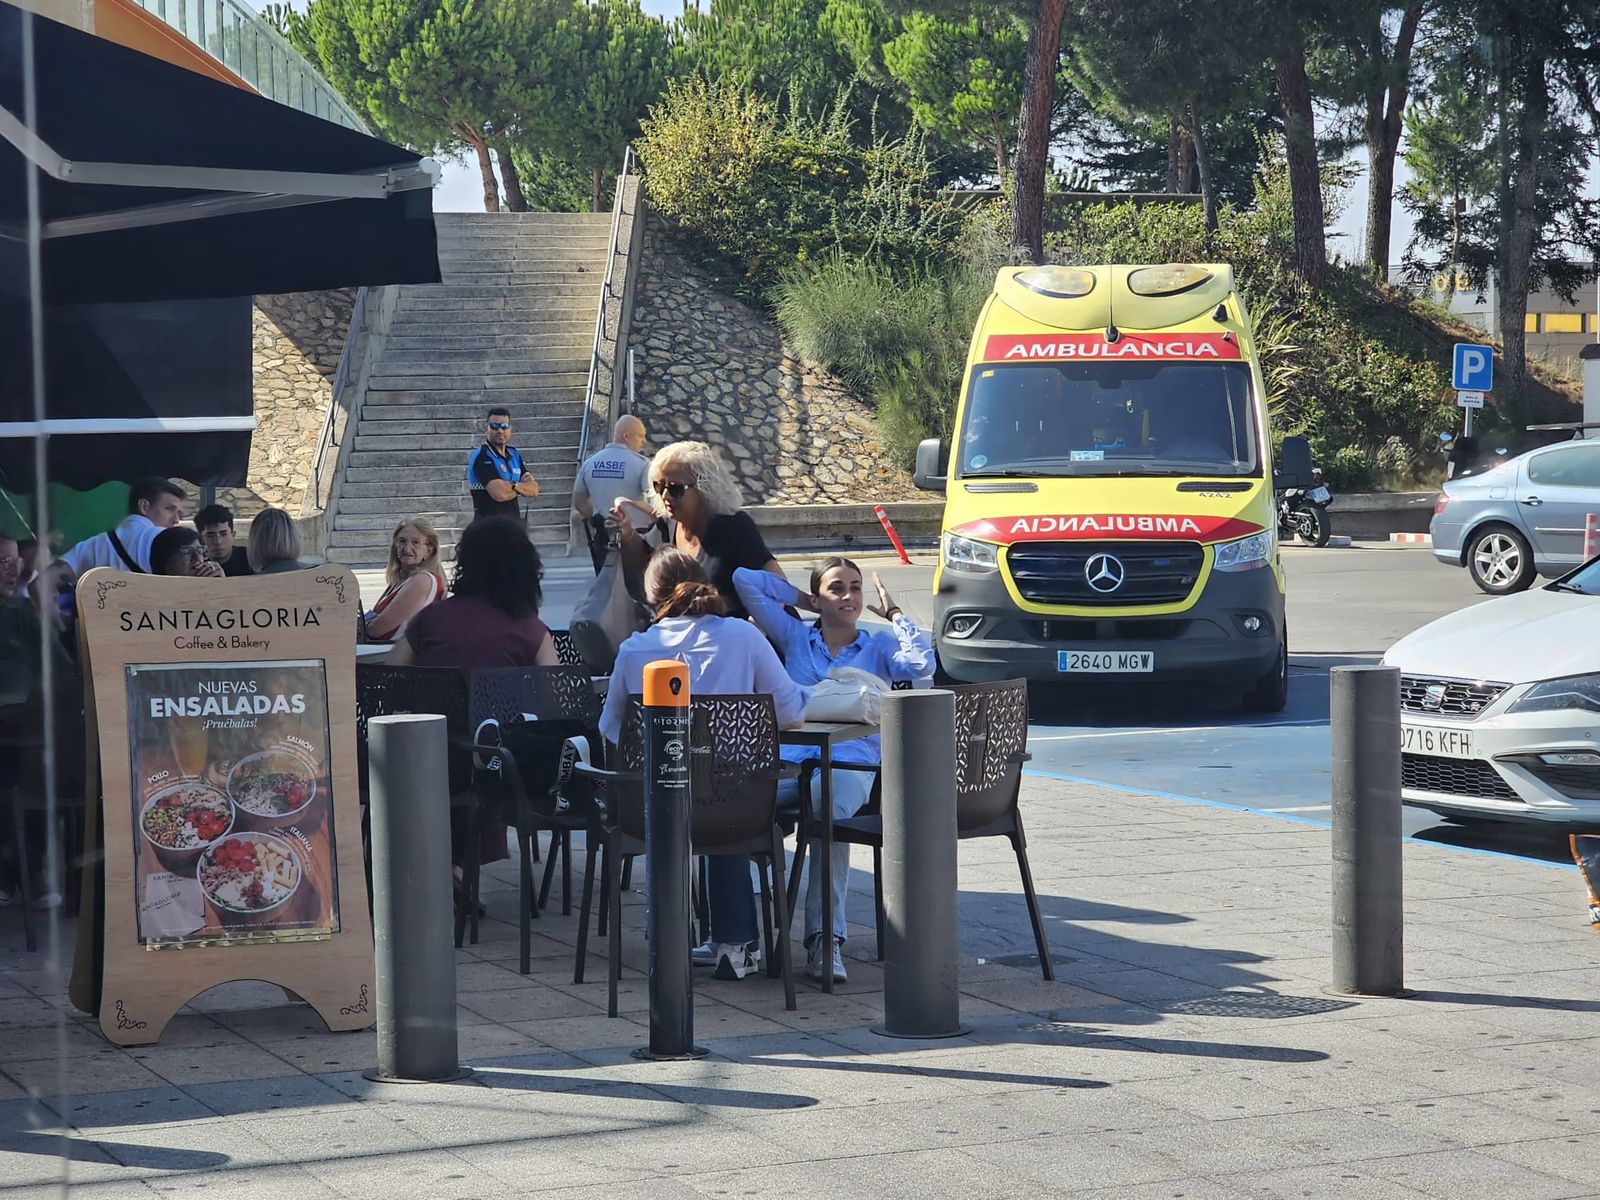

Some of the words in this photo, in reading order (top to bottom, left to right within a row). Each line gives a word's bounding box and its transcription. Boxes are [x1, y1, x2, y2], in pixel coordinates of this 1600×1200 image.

[1004, 342, 1219, 358] AMBULANCIA
[1462, 350, 1485, 385] P
[593, 461, 625, 470] VASBE
[120, 607, 321, 631] SANTAGLORIA
[174, 636, 214, 650] Coffee
[217, 637, 228, 649] &
[231, 635, 270, 651] Bakery
[1070, 654, 1112, 669] 2640
[1118, 654, 1150, 669] MGW
[198, 680, 257, 694] NUEVAS
[151, 694, 306, 718] ENSALADAS
[202, 718, 258, 731] ¡Pruébalas!
[1439, 731, 1470, 755] KFH
[147, 770, 169, 784] POLLO
